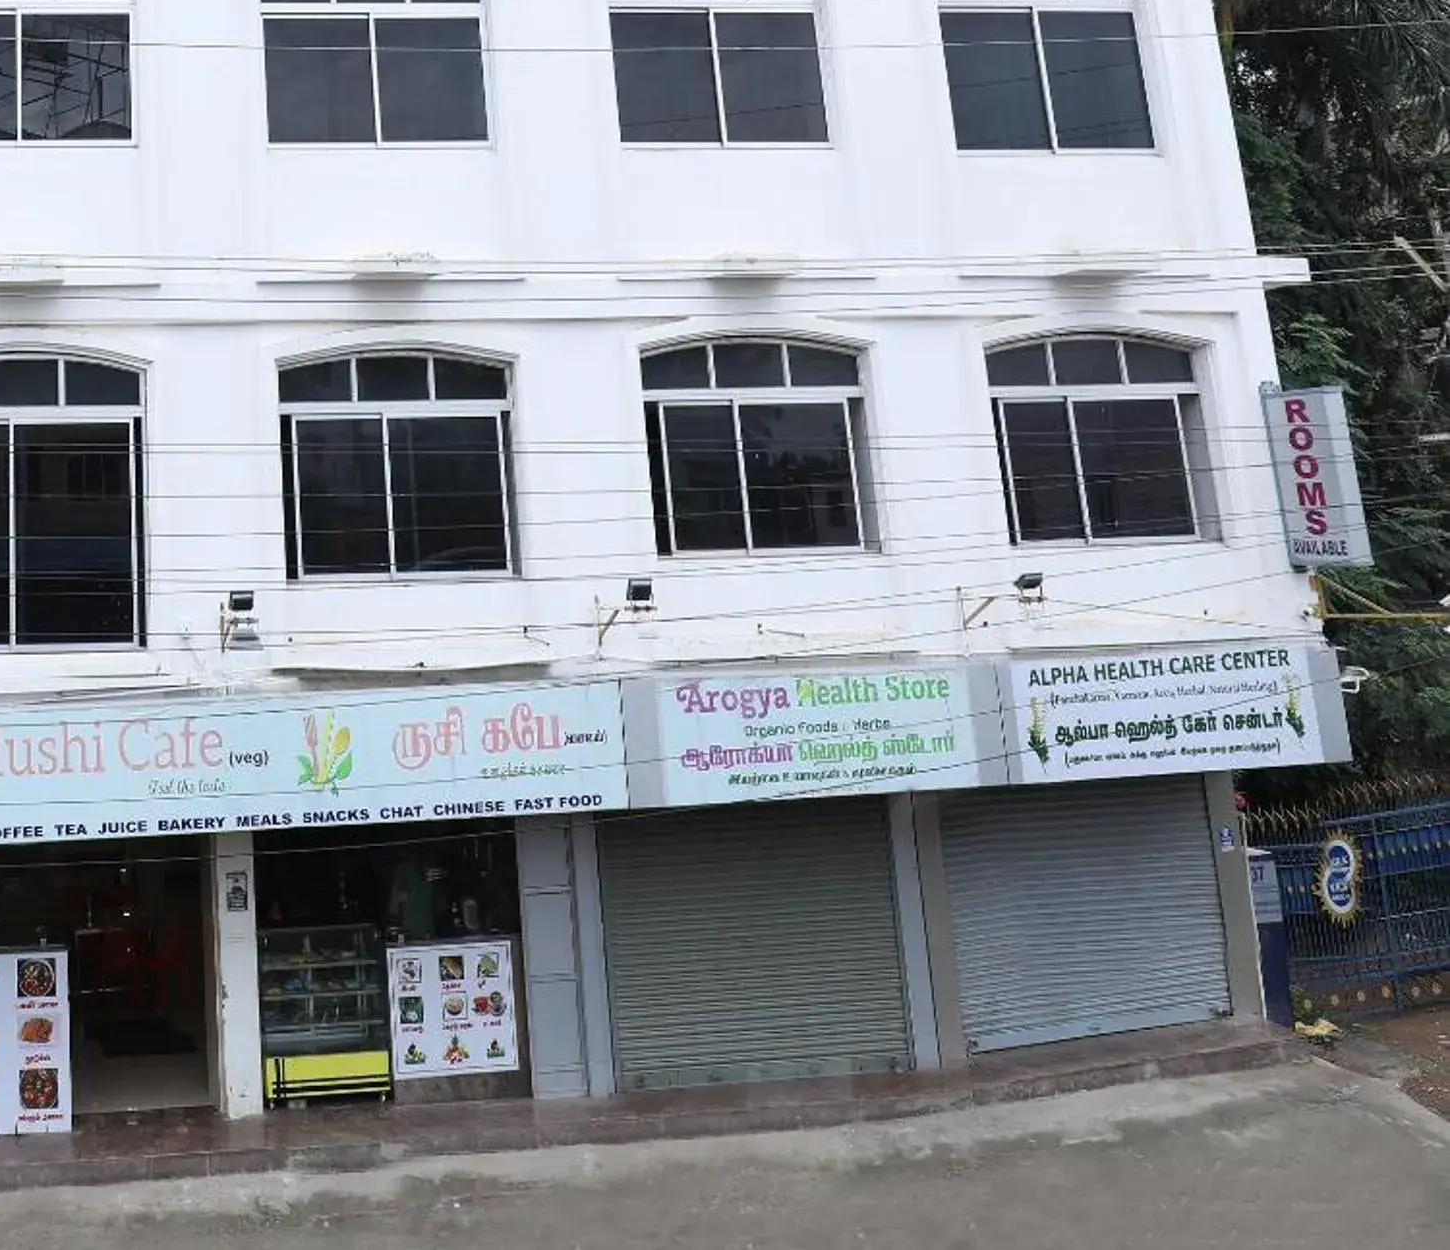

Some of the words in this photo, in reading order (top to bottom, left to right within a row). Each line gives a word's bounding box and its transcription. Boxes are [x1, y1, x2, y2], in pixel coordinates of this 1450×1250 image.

[1284, 398, 1328, 536] ROOMS
[1028, 665, 1088, 687] ALPHA
[1093, 659, 1163, 681] HEALTH
[1168, 654, 1215, 675] CARE
[1221, 649, 1290, 671] CENTER
[676, 682, 791, 719] Arogya
[795, 676, 879, 707] Health
[884, 672, 950, 701] Store
[118, 716, 223, 771] Cafe
[228, 749, 269, 766] (veg)
[393, 705, 466, 771] ருசி
[481, 702, 564, 754] கபே
[54, 823, 87, 836] TEA
[98, 820, 147, 834] JUICE
[158, 816, 225, 831] BAKERY
[236, 813, 292, 827] MEALS
[302, 810, 369, 824] SNACKS
[380, 805, 423, 819] CHAT
[433, 801, 505, 816] CHINESE
[515, 797, 552, 810] FAST
[559, 795, 603, 808] FOOD
